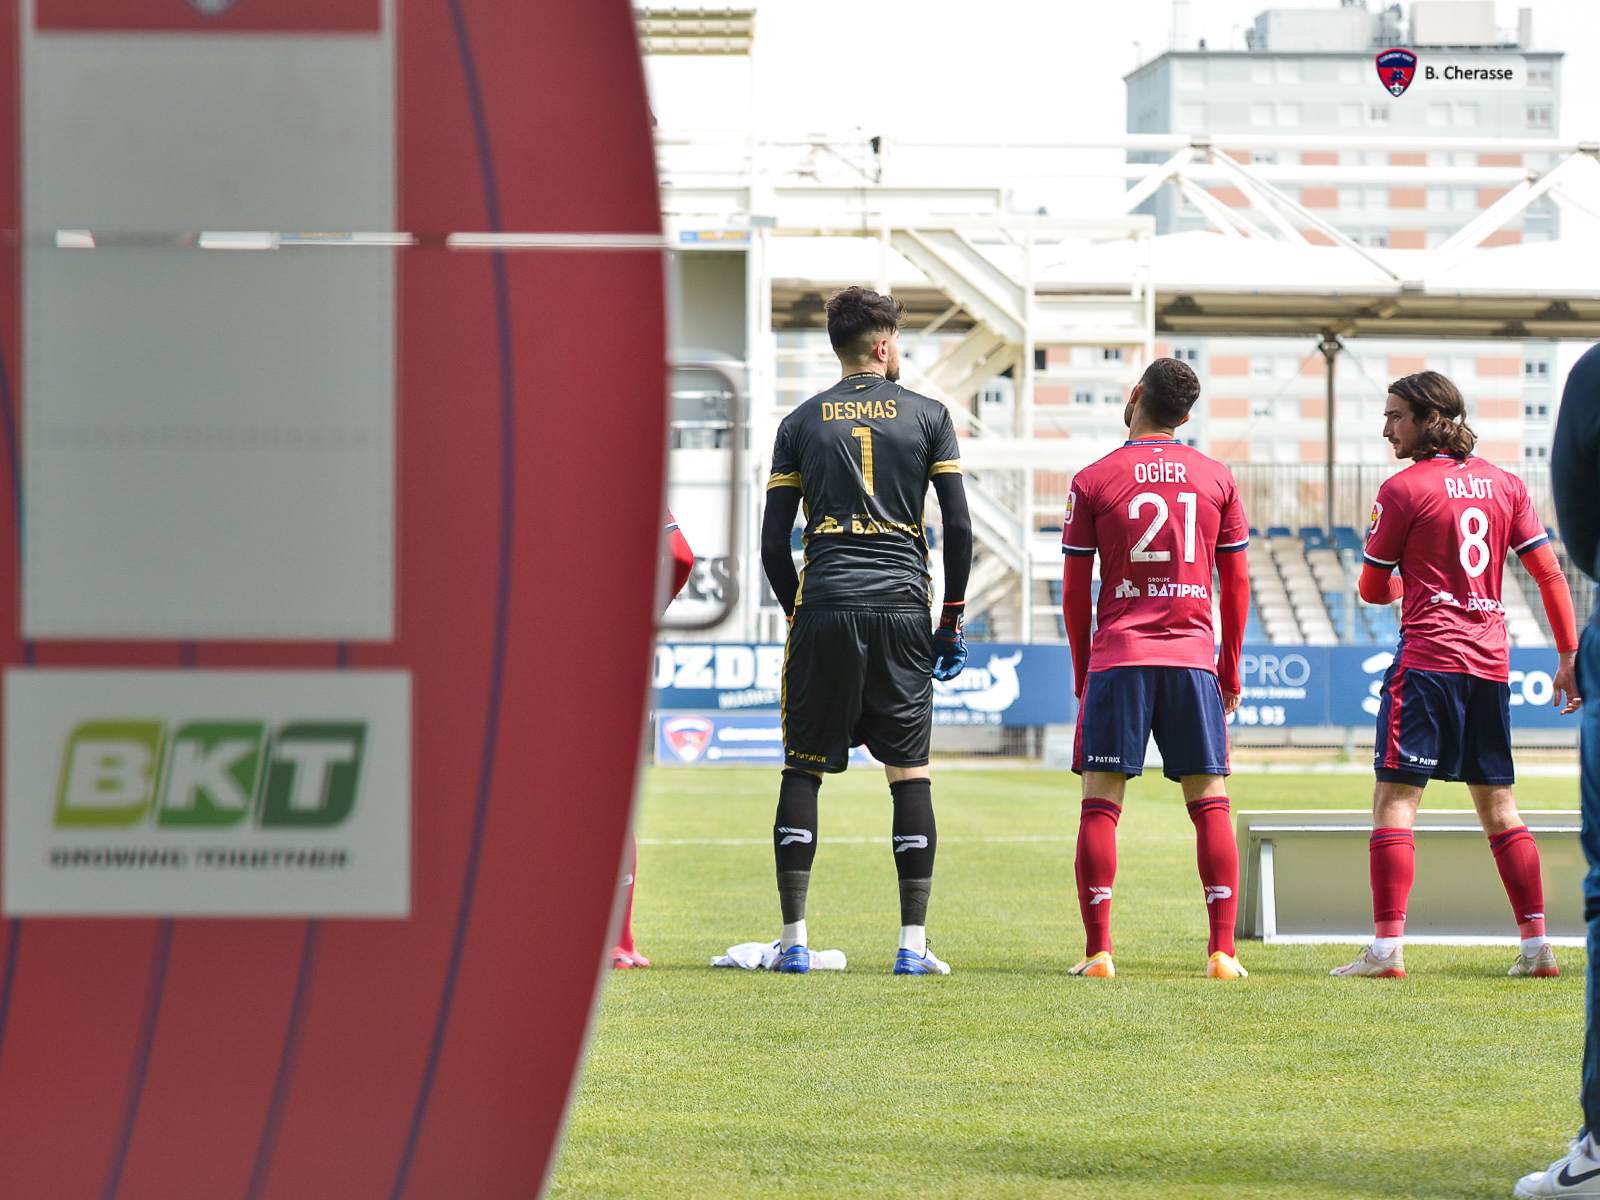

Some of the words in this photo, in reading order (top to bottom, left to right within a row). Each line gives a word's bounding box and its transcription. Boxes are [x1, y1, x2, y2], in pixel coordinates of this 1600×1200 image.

[822, 399, 898, 422] DESMAS
[851, 426, 875, 497] 1
[1128, 492, 1198, 564] 21
[1459, 506, 1491, 579] 8
[1147, 583, 1208, 599] BATIPRO
[60, 732, 360, 817] BKT
[796, 752, 827, 763] PATRICK
